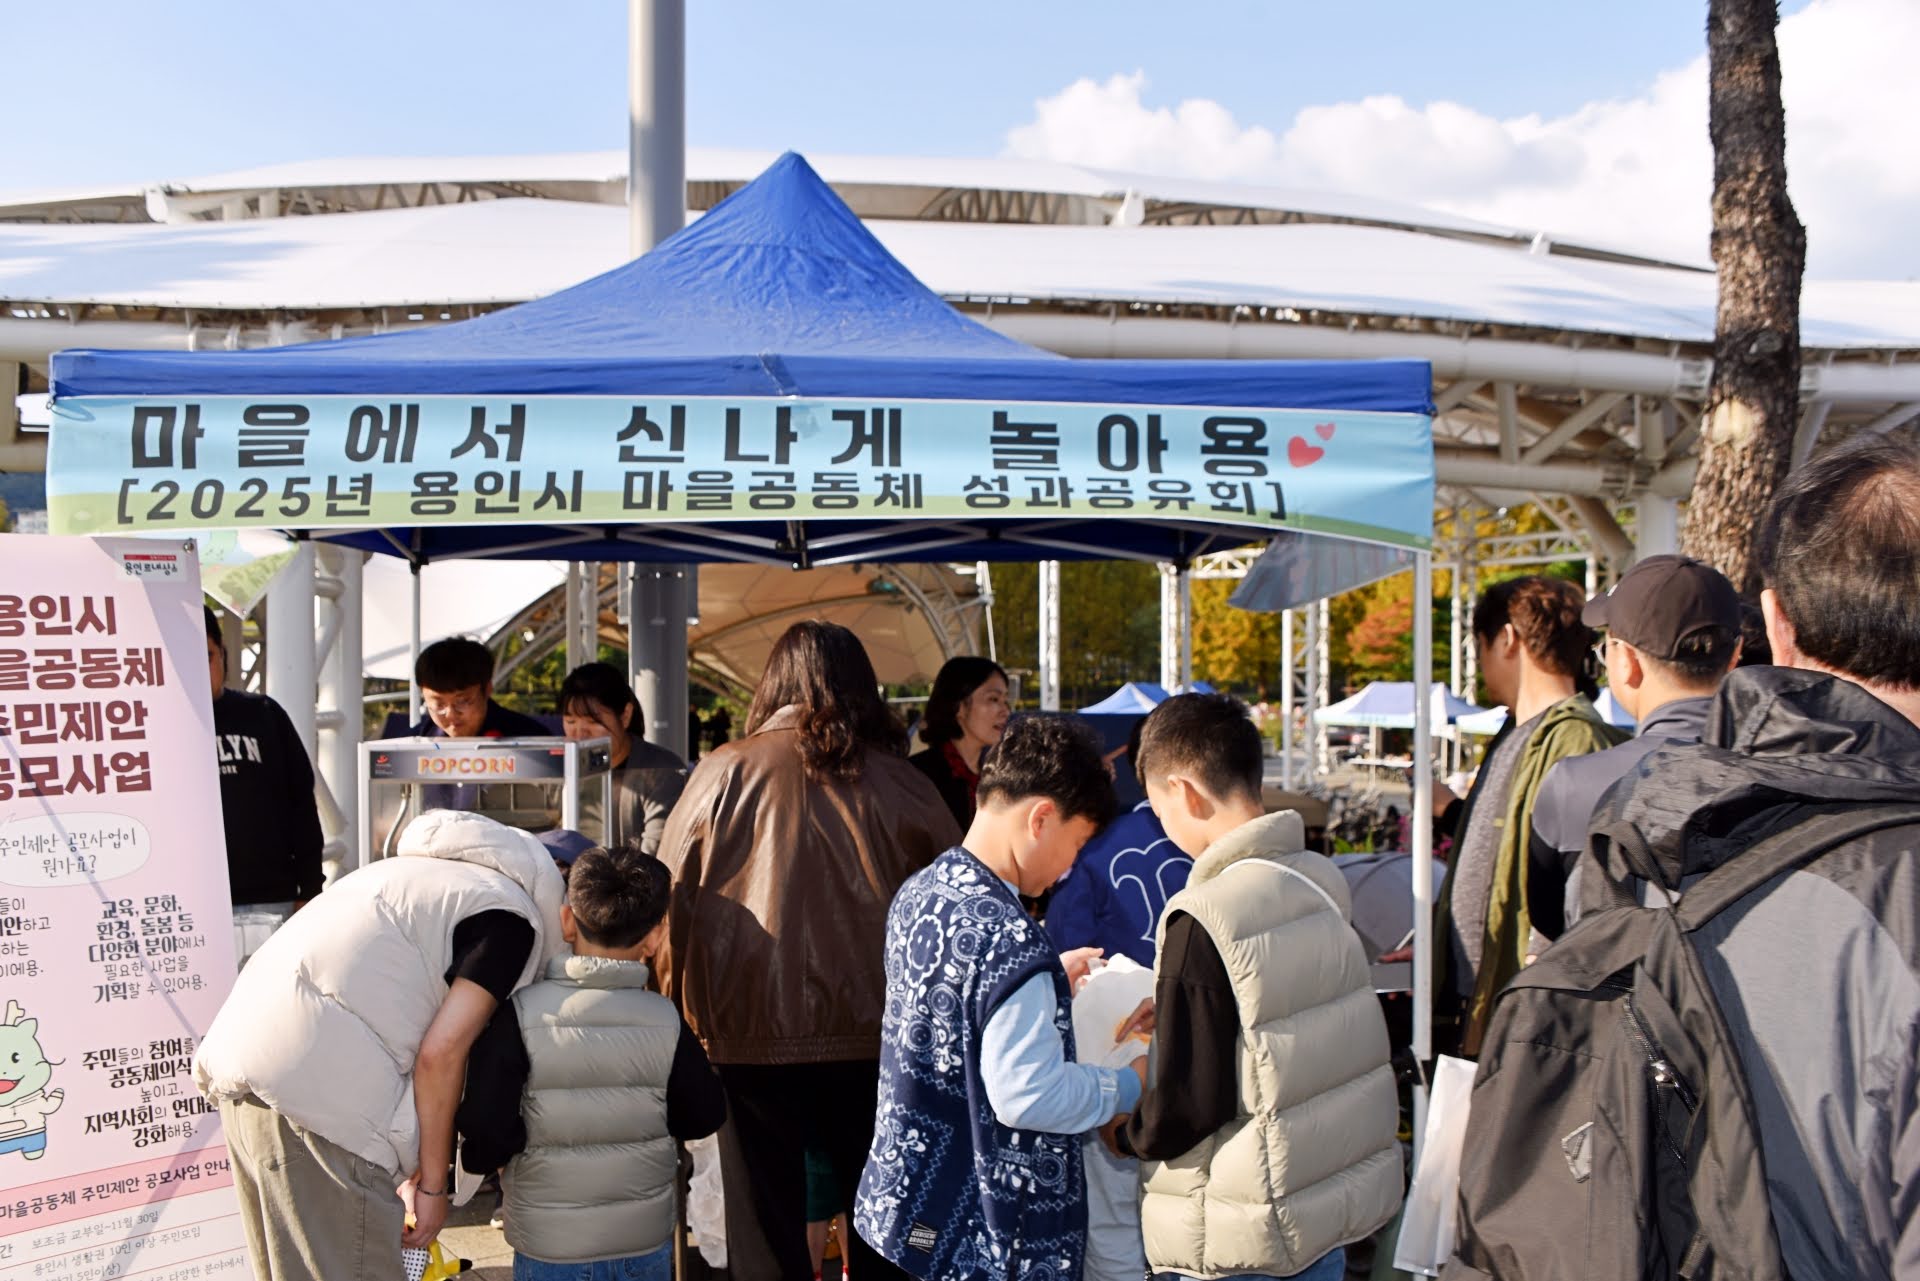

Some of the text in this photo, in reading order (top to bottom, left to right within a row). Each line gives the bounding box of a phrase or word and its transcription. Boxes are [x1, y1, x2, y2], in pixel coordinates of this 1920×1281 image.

[132, 404, 1269, 477] 마을에서 신나게 놀아용
[117, 470, 1287, 524] [2025년 용인시 마을공동체 성과공유회]
[0, 595, 117, 636] 용인시
[417, 756, 516, 775] POPCORN
[0, 828, 137, 857] 주민제안 공모사업이
[101, 895, 183, 919] 교육, 문화,
[97, 913, 194, 939] 환경, 돌봄 등
[88, 935, 206, 962] 다양한 분야에서
[104, 956, 189, 980] 필요한 사업을
[94, 974, 207, 1003] 기획할 수 있어용.
[82, 1037, 194, 1070] 주민들의 참여를
[140, 1083, 184, 1103] 높이고,
[84, 1105, 167, 1135] 지역사회의
[132, 1121, 198, 1148] 강화해용.
[0, 1190, 76, 1218] 마을공동체
[81, 1177, 140, 1202] 주민제안
[145, 1165, 201, 1189] 공모사업
[137, 1211, 159, 1225] 30일
[33, 1258, 67, 1276] 용인시
[136, 1236, 156, 1249] 이상
